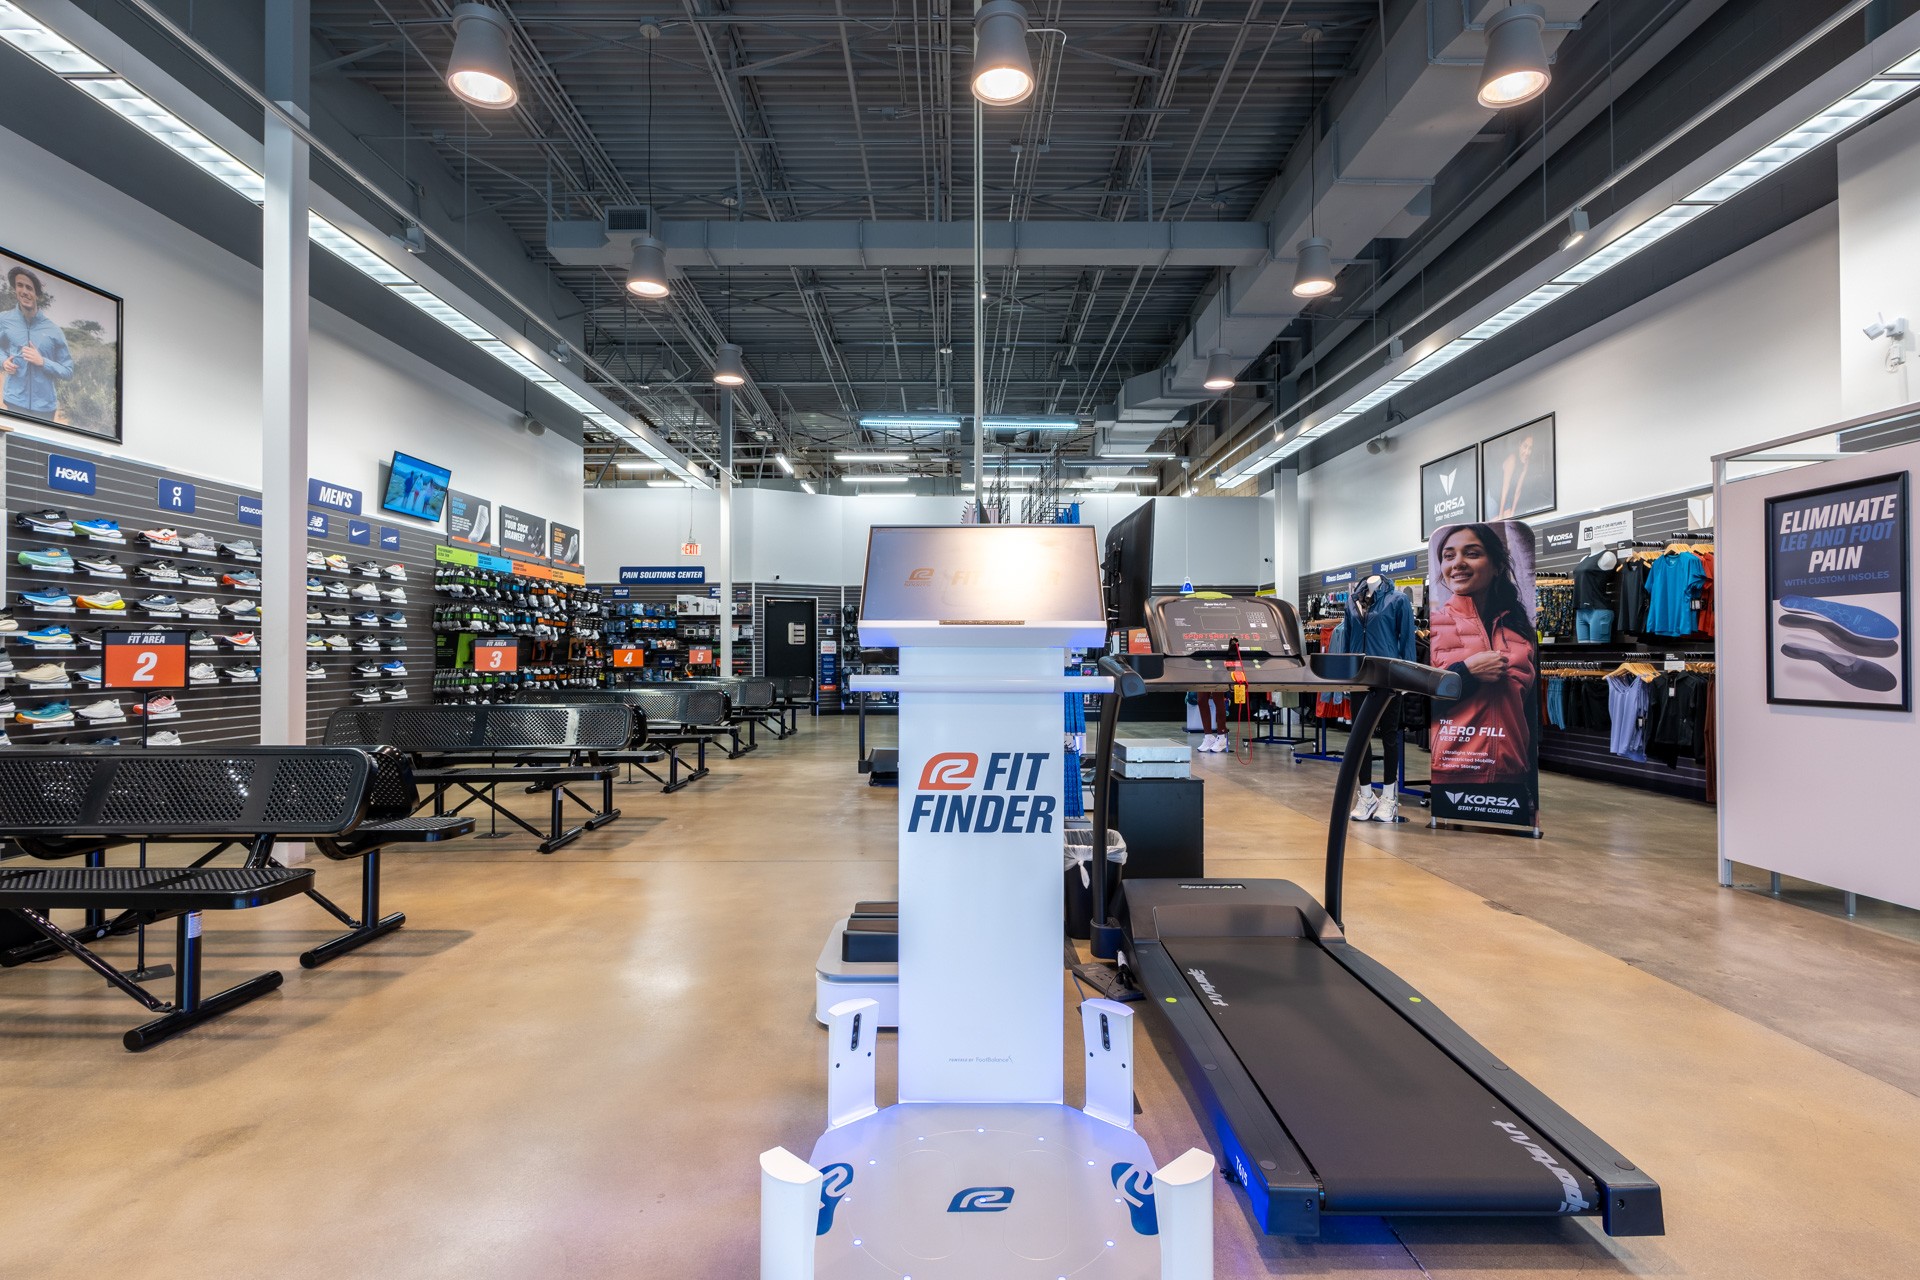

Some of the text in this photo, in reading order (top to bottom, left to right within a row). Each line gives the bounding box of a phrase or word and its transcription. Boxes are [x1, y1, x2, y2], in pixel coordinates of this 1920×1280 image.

[55, 467, 89, 483] HOKA
[318, 486, 353, 508] MEN'S
[1433, 495, 1466, 515] KORSA
[1779, 493, 1898, 535] ELIMINATE
[504, 519, 529, 534] YOUR SOCK
[504, 530, 526, 543] DRAWER?
[1553, 532, 1574, 542] KORSA
[1779, 520, 1896, 553] LEG AND FOOT
[685, 545, 699, 555] EXIT
[1380, 559, 1407, 572] Stay Hydrated
[1808, 545, 1864, 574] PAIN
[640, 571, 676, 579] SOLUTIONS
[677, 571, 703, 579] CENTER
[1784, 570, 1890, 587] WITH CUSTOM INSOLES
[127, 635, 166, 644] FIT AREA
[489, 650, 503, 668] 3
[623, 652, 633, 664] 4
[697, 652, 704, 662] 5
[132, 651, 158, 682] 2
[1439, 725, 1506, 737] AERO FILL
[983, 752, 1050, 791] FIT
[1463, 794, 1520, 808] KORSA
[907, 794, 1056, 833] FINDER
[1487, 807, 1514, 815] COURSE
